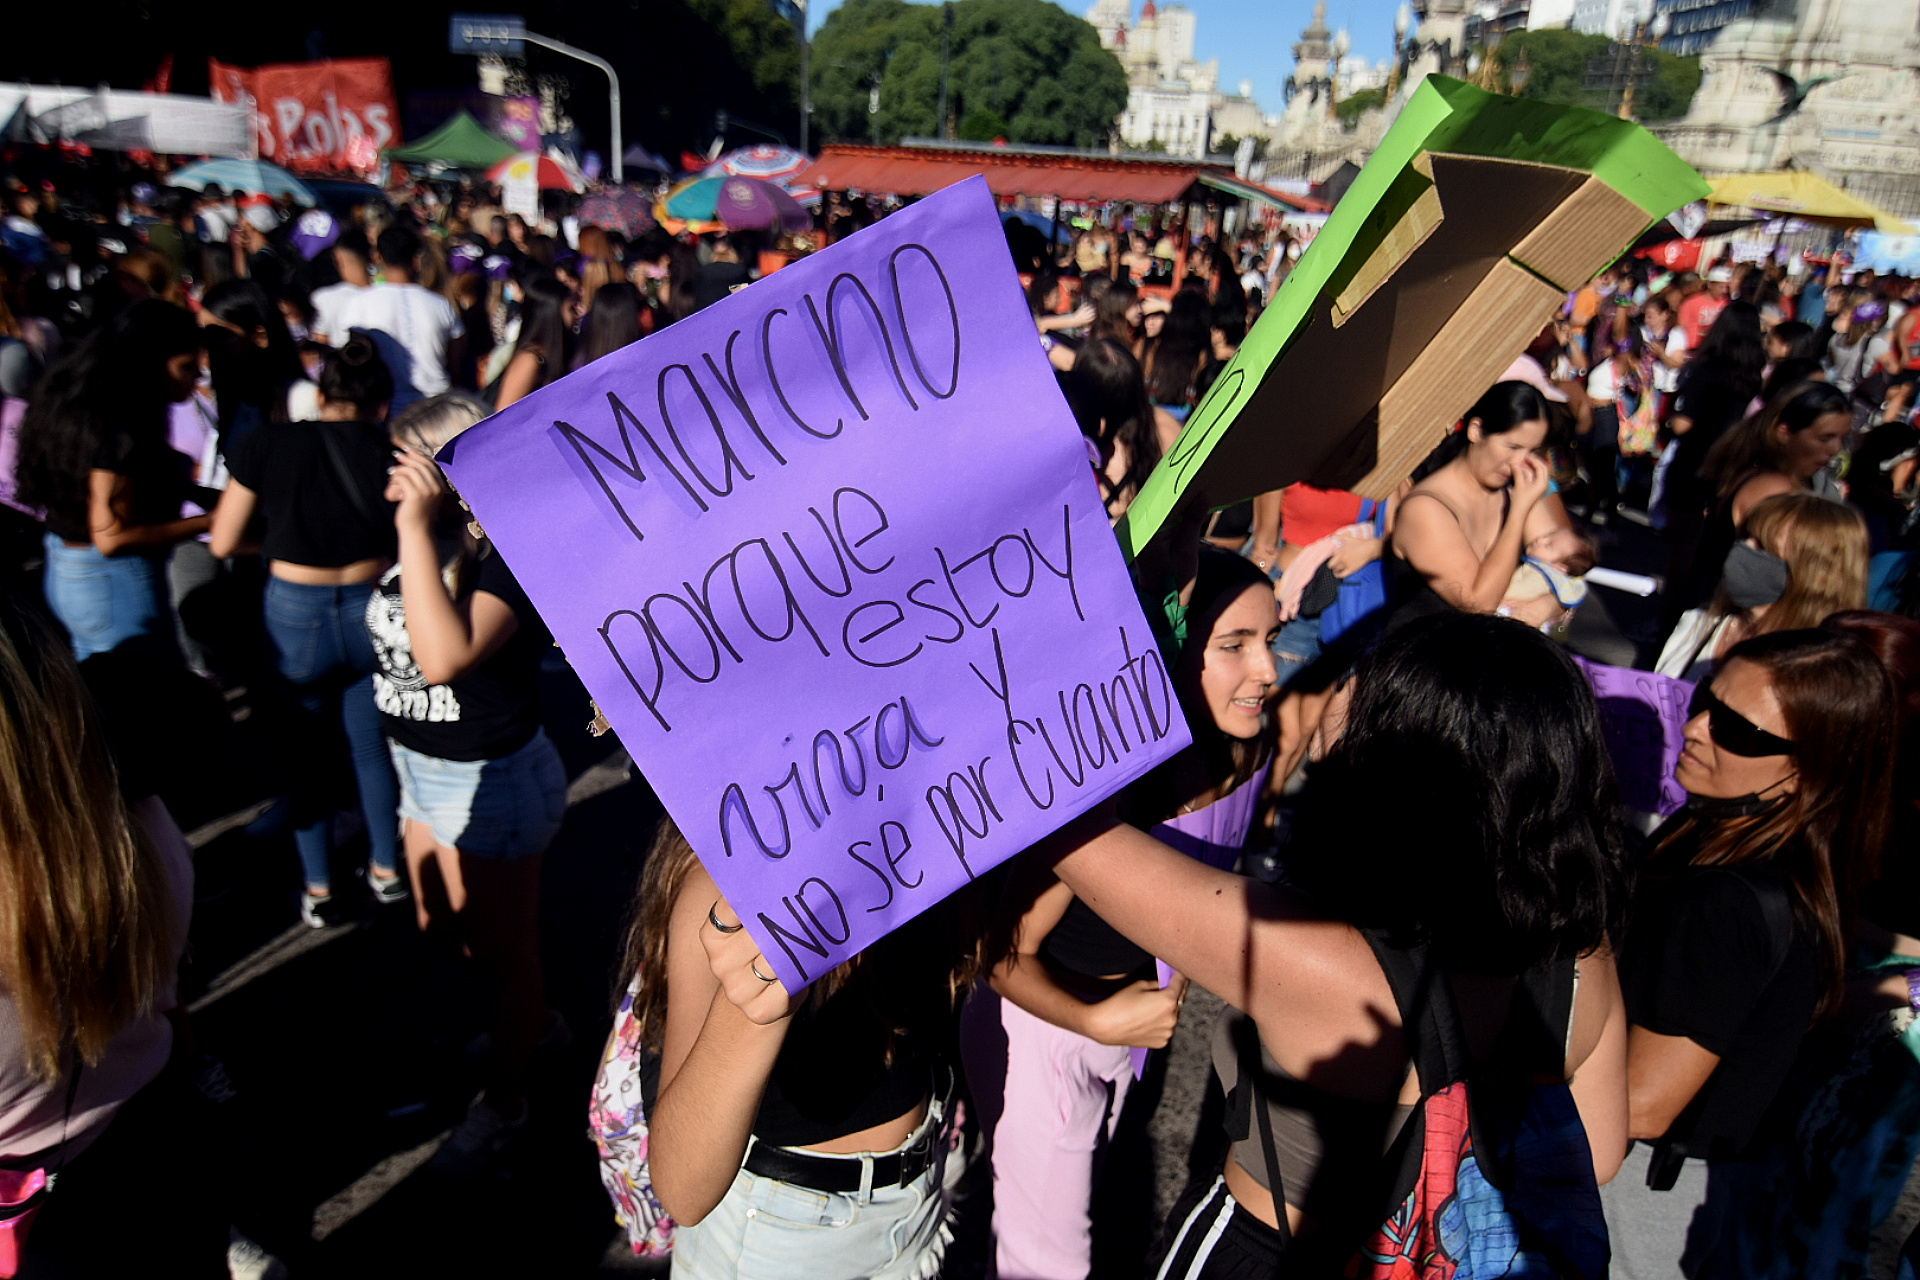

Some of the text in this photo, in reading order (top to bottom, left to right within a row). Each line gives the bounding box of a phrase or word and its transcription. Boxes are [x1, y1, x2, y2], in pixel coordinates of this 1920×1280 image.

[597, 488, 894, 731] porque
[843, 505, 1084, 667] estoy
[720, 696, 945, 859] viva
[926, 757, 1004, 881] por
